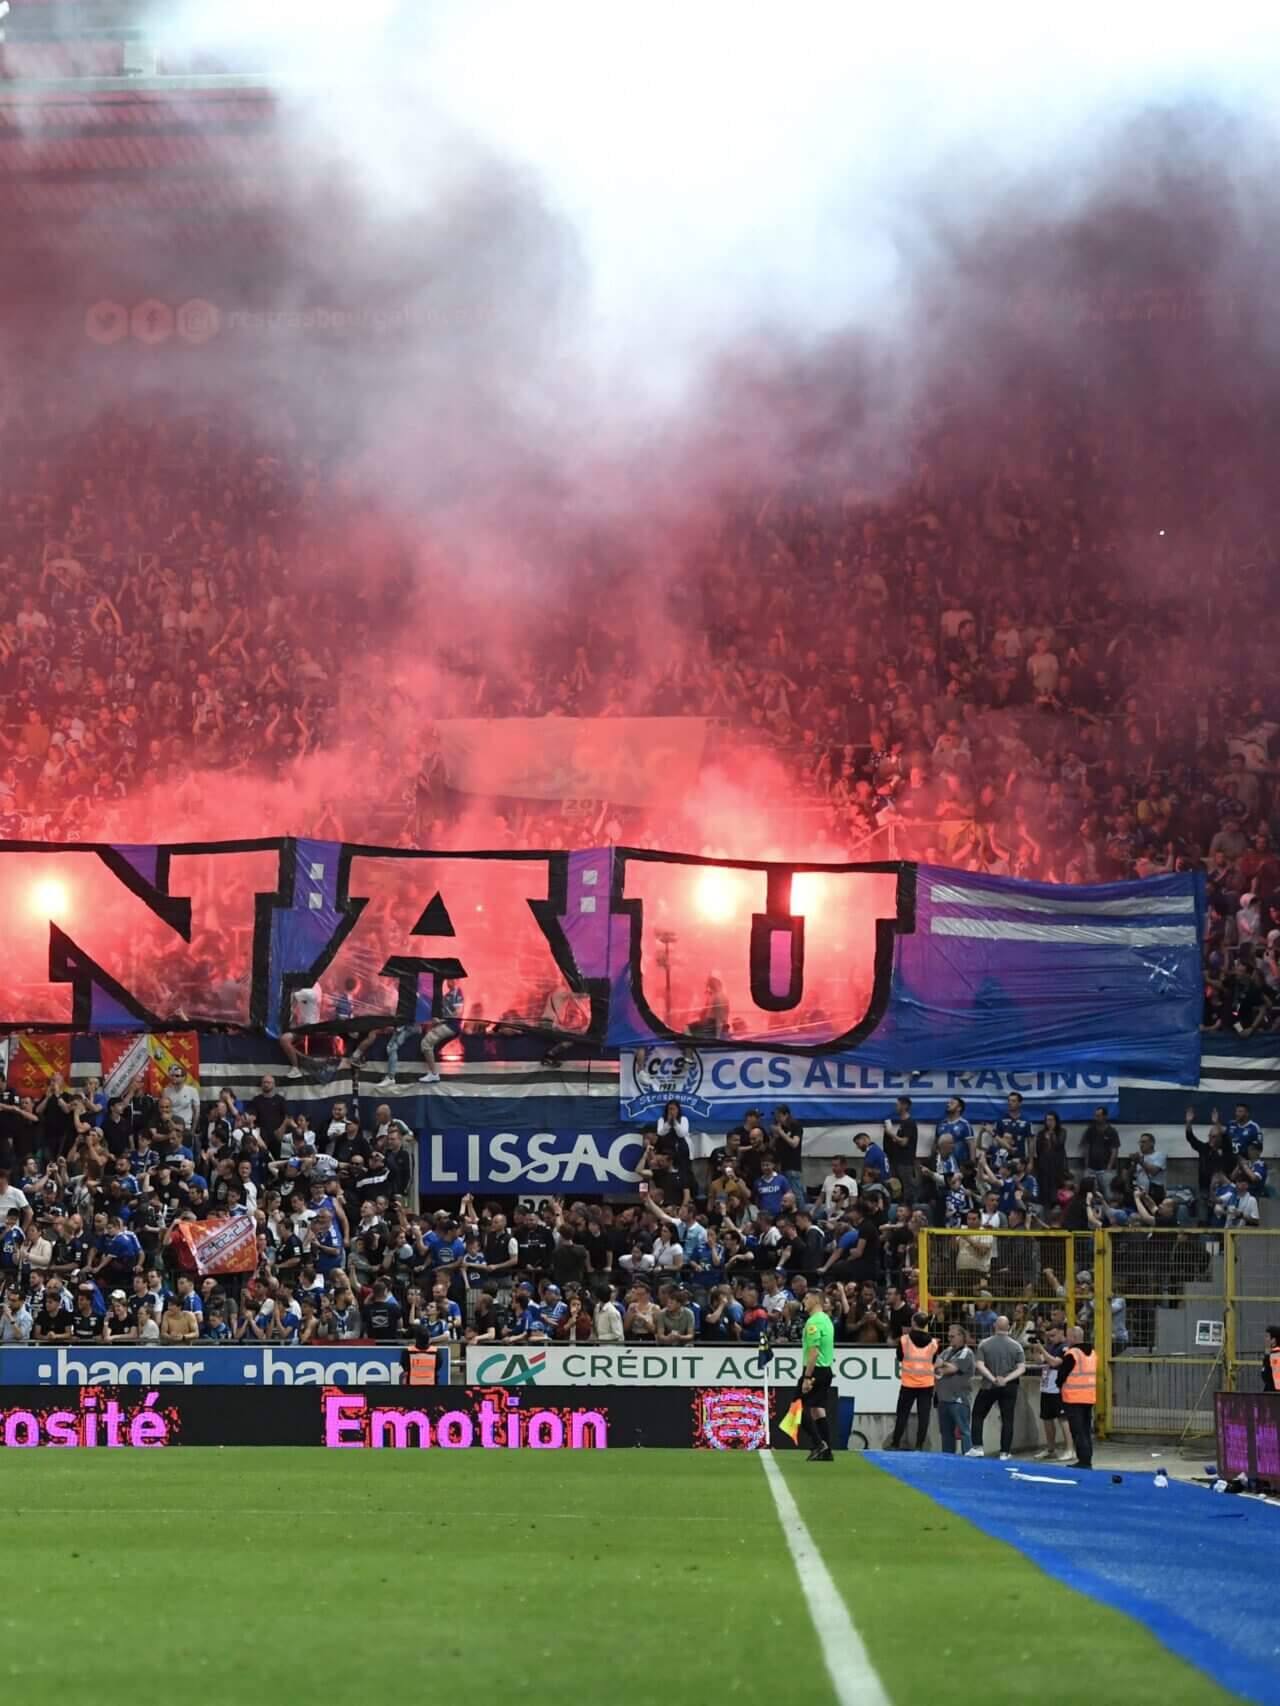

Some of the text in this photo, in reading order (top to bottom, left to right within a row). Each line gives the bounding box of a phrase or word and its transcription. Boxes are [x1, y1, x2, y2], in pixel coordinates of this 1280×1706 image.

[648, 1056, 687, 1075] CCS
[711, 1056, 792, 1090] CCS
[431, 1132, 645, 1183] LISSAC
[562, 1350, 704, 1379] CRÉDIT
[716, 1356, 904, 1380] AGROL
[325, 1394, 608, 1449] Emotion
